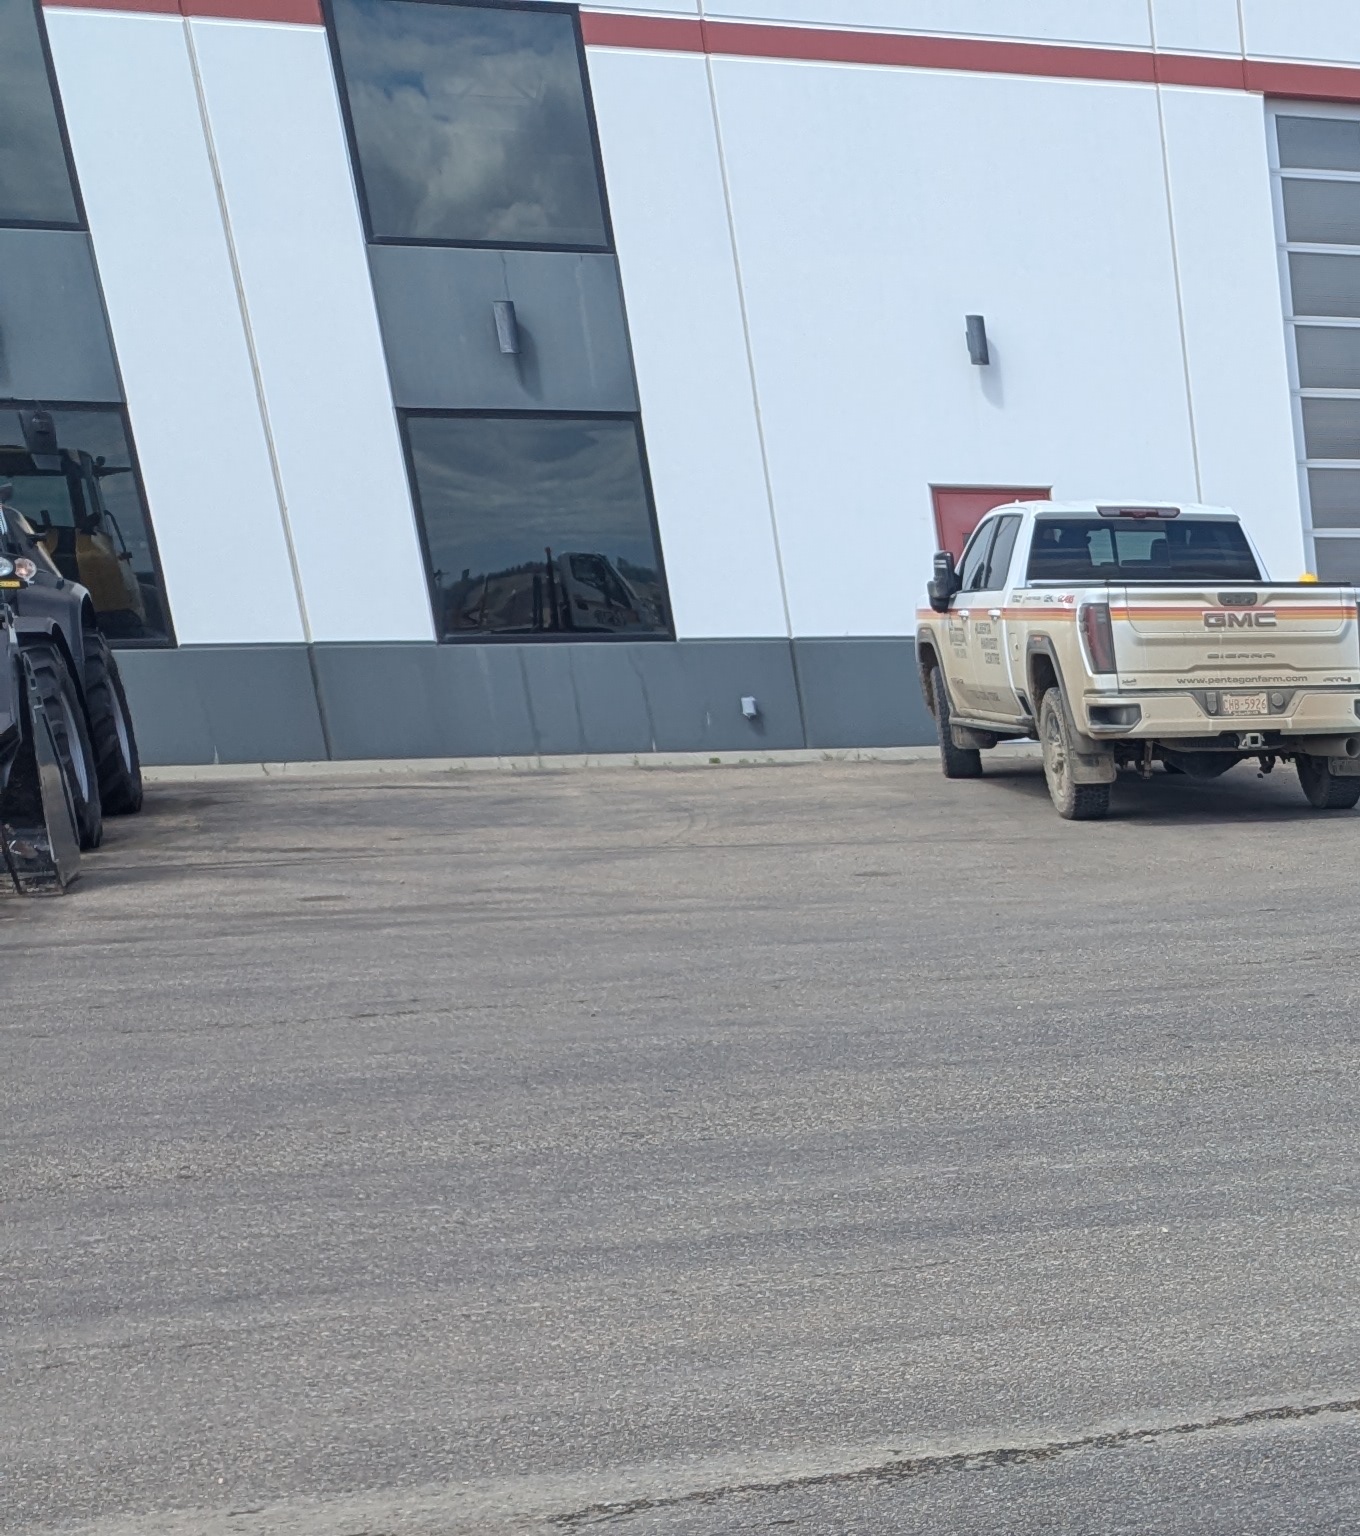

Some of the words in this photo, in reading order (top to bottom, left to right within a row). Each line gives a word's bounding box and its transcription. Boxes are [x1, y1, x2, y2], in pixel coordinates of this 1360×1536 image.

[1203, 612, 1277, 628] GMC
[1207, 652, 1276, 660] SIERRA
[1176, 674, 1308, 685] www.pentagonfarm.com
[1224, 698, 1266, 710] CHB-5926
